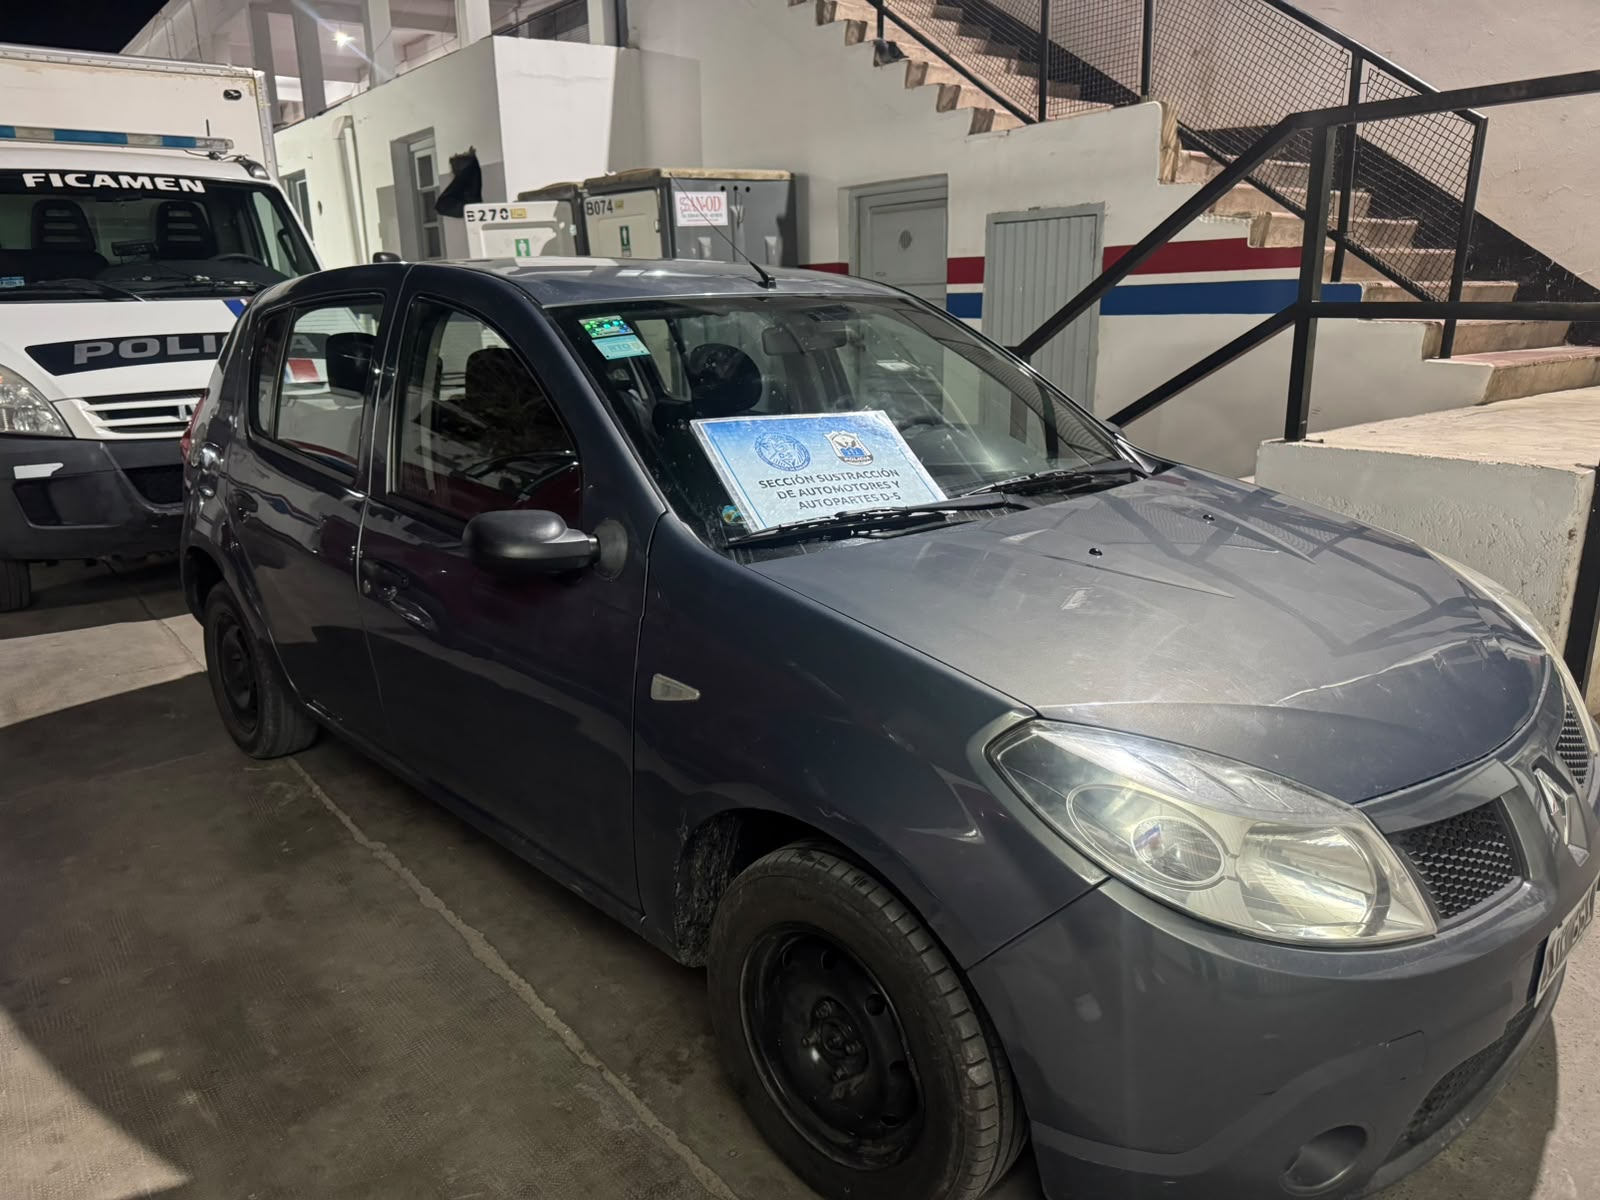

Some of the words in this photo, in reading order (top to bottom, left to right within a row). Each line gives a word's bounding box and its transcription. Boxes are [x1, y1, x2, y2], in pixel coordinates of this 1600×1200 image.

[22, 172, 207, 194] FICAMEN
[586, 200, 613, 216] B074
[758, 474, 816, 489] SECCIÓN
[816, 468, 900, 482] SUSTRACCIÓN
[776, 489, 797, 500] DE
[799, 480, 887, 497] AUTOMOTORES
[892, 480, 901, 489] Y
[799, 493, 879, 511] AUTOPARTES
[880, 491, 902, 502] D-5
